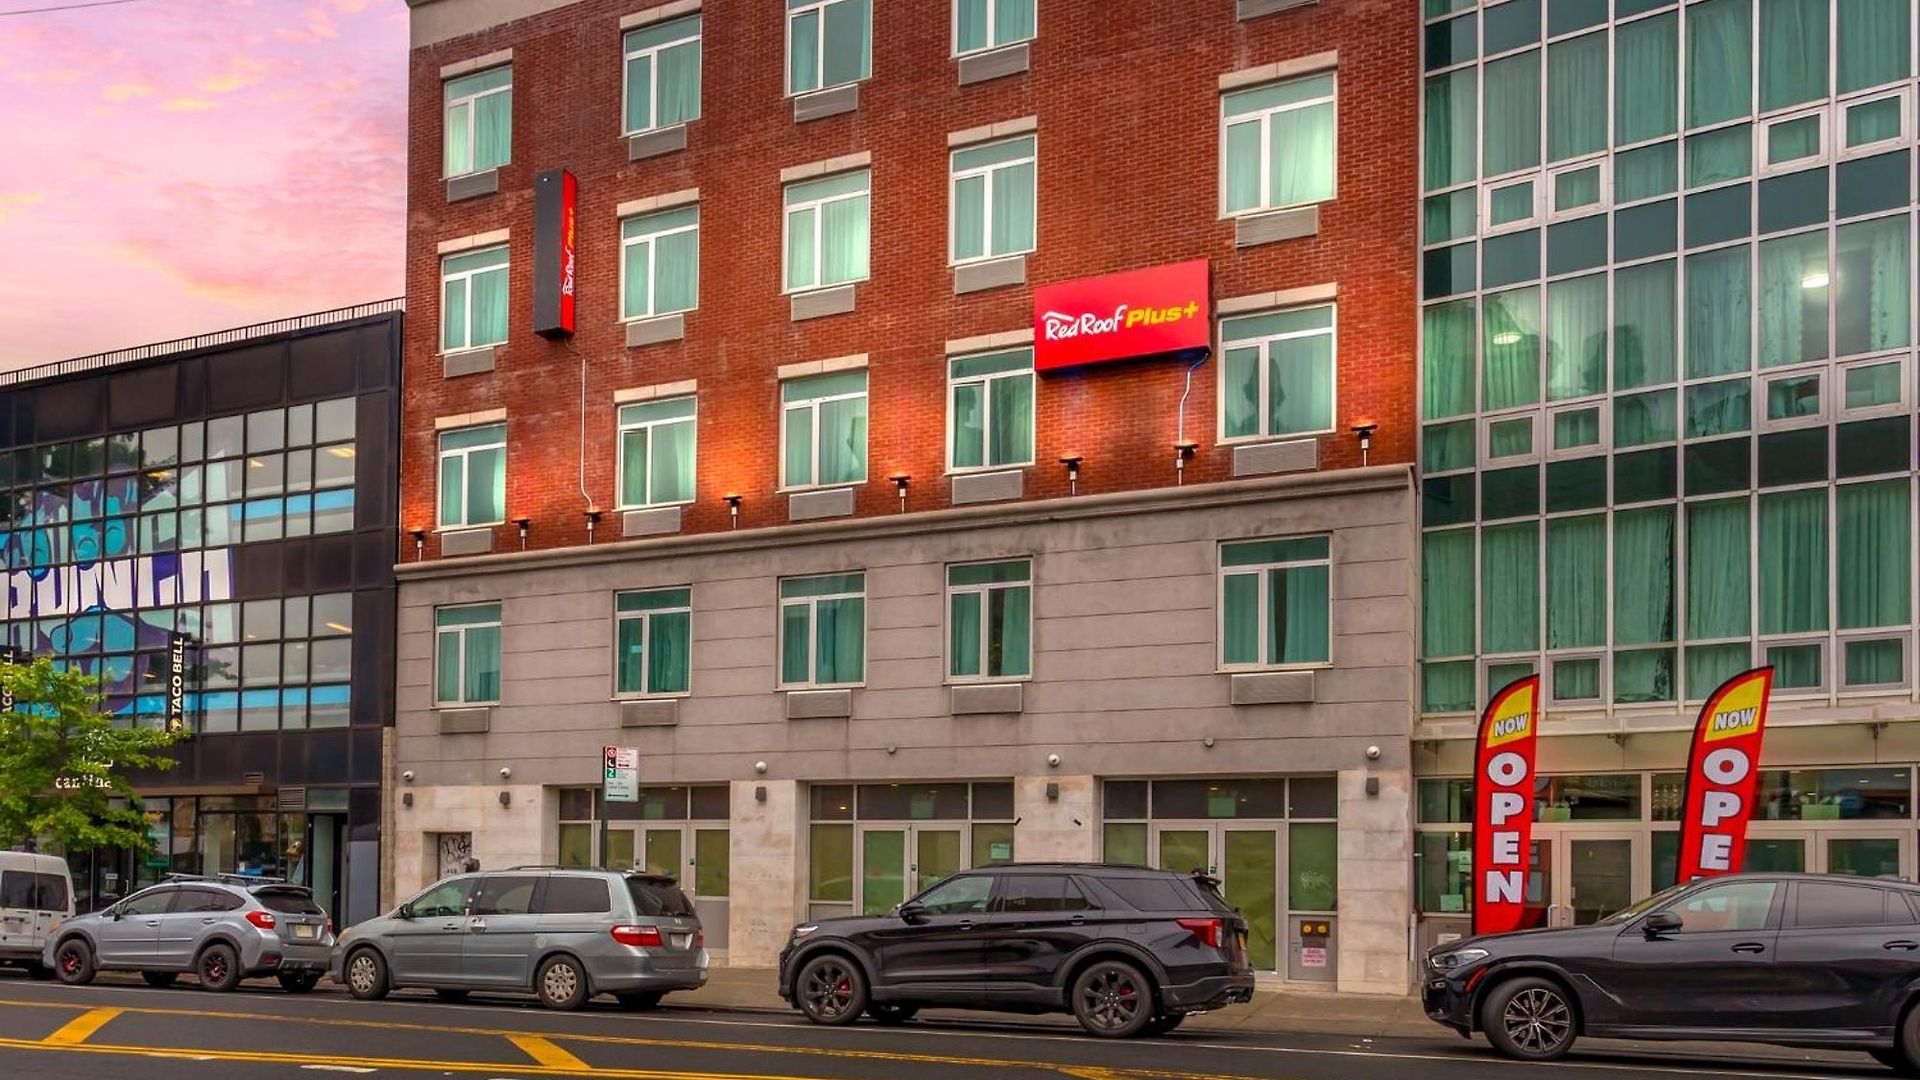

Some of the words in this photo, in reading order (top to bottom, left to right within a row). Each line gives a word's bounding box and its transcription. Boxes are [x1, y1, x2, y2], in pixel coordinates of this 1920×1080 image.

[1125, 301, 1199, 329] Plus+
[172, 637, 184, 673] BELL
[171, 675, 182, 716] TACO
[1493, 713, 1528, 738] NOW
[1713, 707, 1756, 732] NOW
[1486, 752, 1528, 904] OPEN
